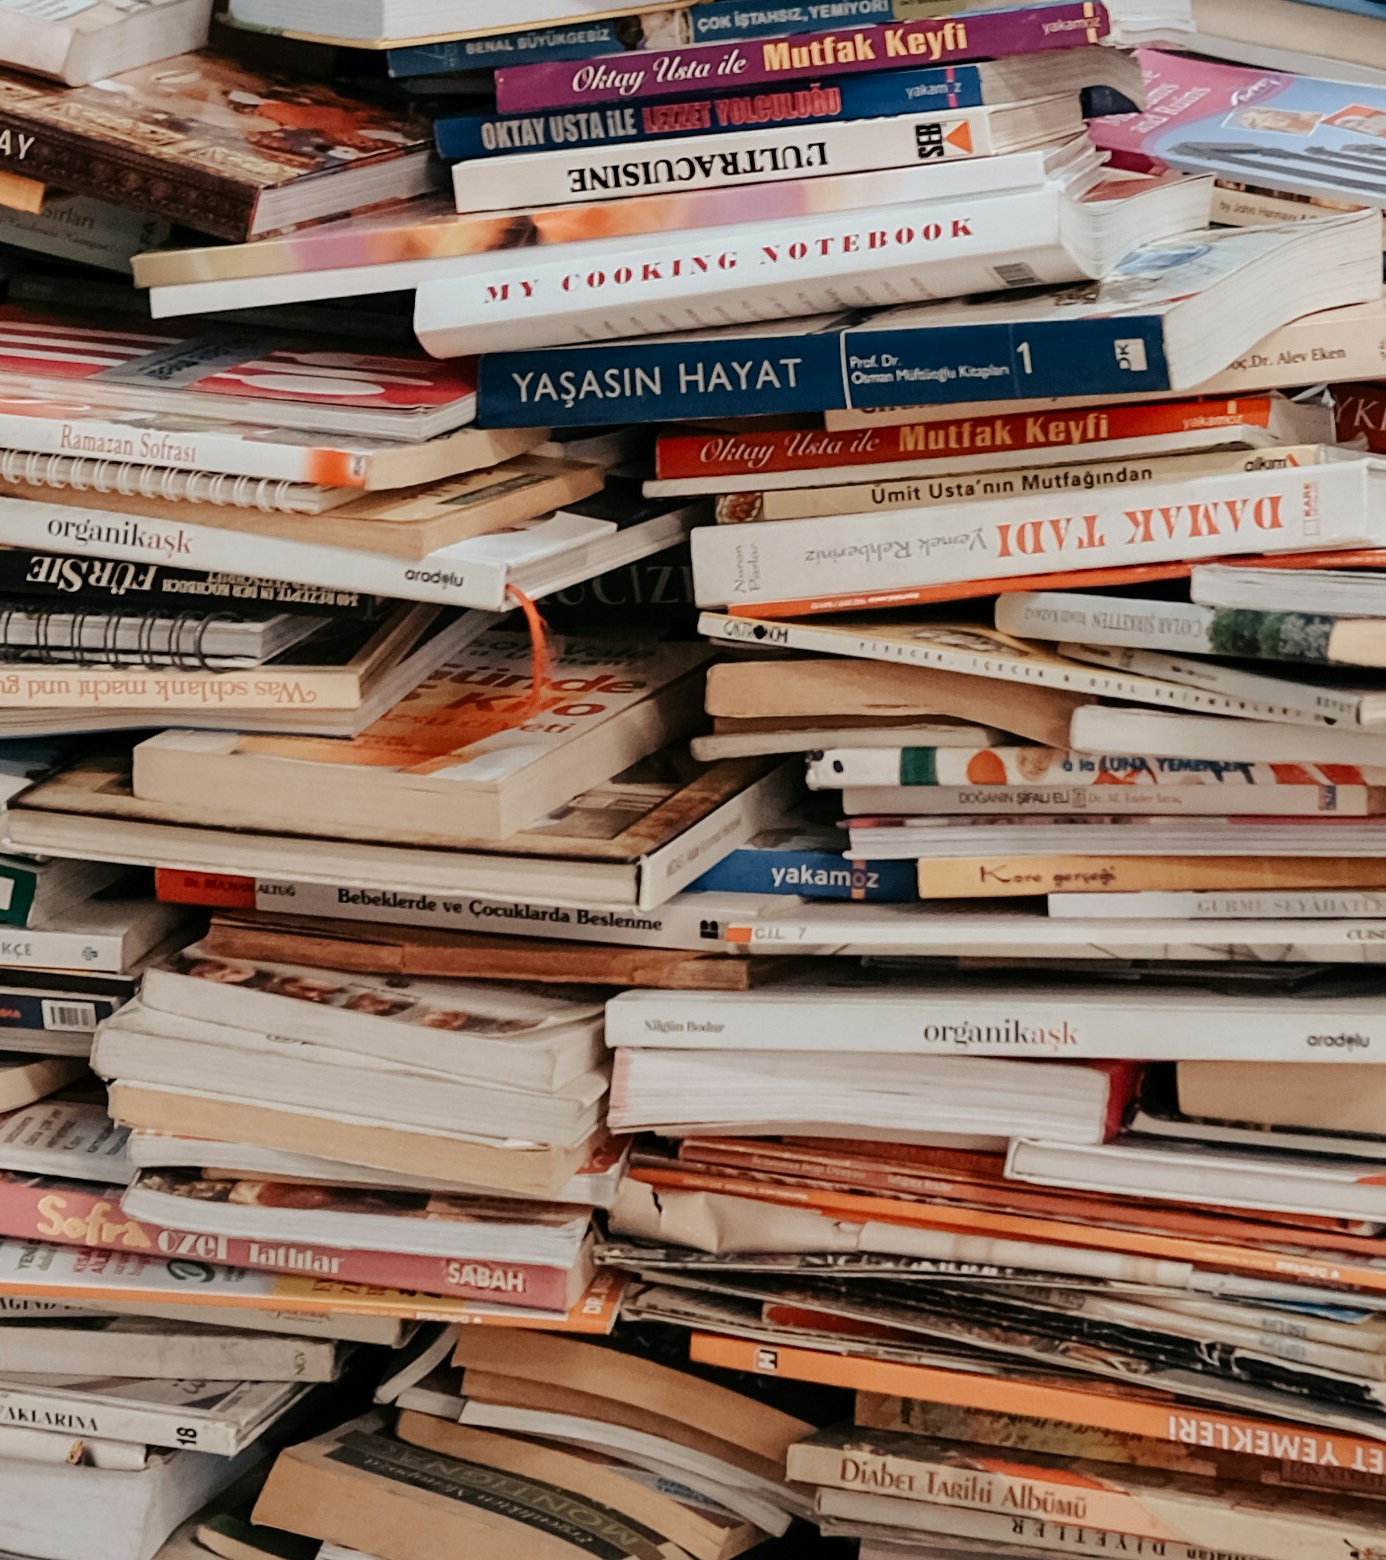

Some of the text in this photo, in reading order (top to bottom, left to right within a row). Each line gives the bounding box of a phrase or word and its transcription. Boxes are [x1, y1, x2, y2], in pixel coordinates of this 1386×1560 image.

[697, 13, 730, 35] ÇOK
[733, 3, 808, 30] İŞTAHSIZ,
[572, 23, 968, 98] Oktay Usta ile Mutfak Keyfi
[915, 121, 946, 159] SEB
[483, 218, 976, 306] MY COOKING NOTEBOOK
[1016, 341, 1032, 375] 1
[510, 356, 804, 410] YAŞASIN HAYAT
[871, 466, 1154, 506] Ümit Usta'nın Mutfağından
[995, 494, 1284, 560] DAMAK TADI
[27, 679, 71, 704] und
[78, 677, 147, 704] macht
[154, 678, 248, 705] schlank
[254, 679, 317, 705] Was
[770, 863, 880, 891] yakamoz
[257, 882, 663, 933] ALTUĞ Bebeklerde ve Çocuklarda Beslenme
[35, 1194, 153, 1251] Sofra
[177, 1425, 198, 1448] 18
[1166, 1413, 1341, 1468] YEMEKLERİ
[839, 1455, 1088, 1521] Diabet Tarihi Albümü
